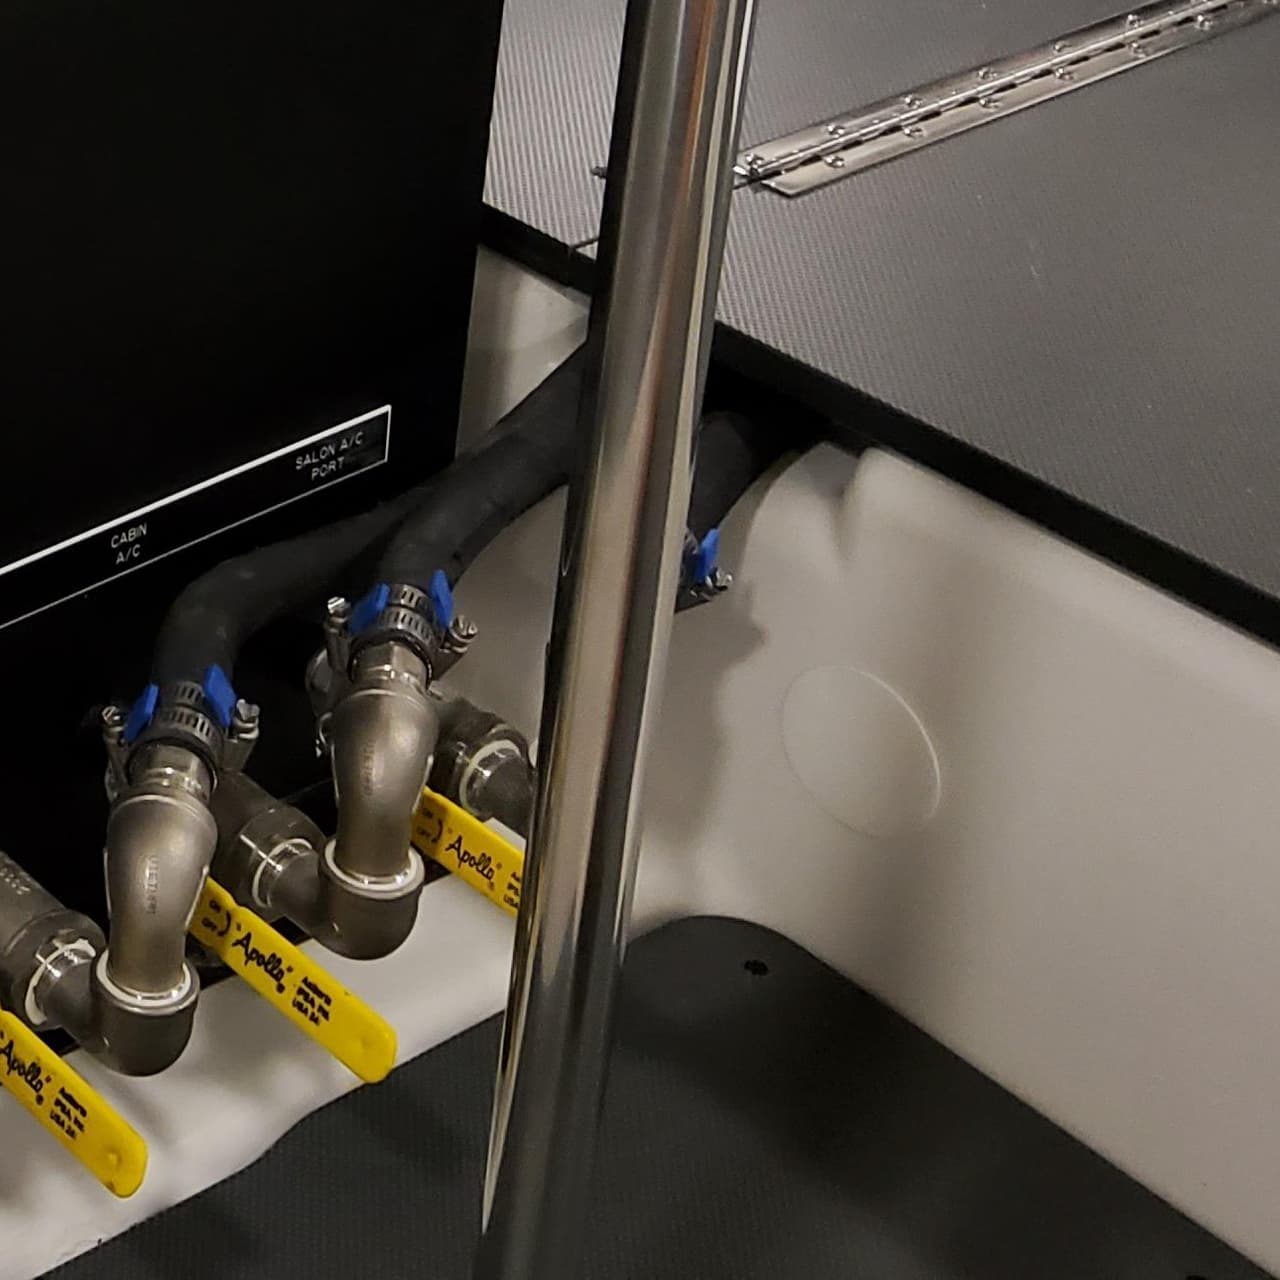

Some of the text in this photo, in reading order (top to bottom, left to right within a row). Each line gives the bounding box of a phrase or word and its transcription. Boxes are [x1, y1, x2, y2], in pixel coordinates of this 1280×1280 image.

[295, 431, 363, 470] SALON A/C
[311, 456, 345, 480] PORT
[111, 521, 147, 548] CABIN
[116, 544, 141, 565] A/C
